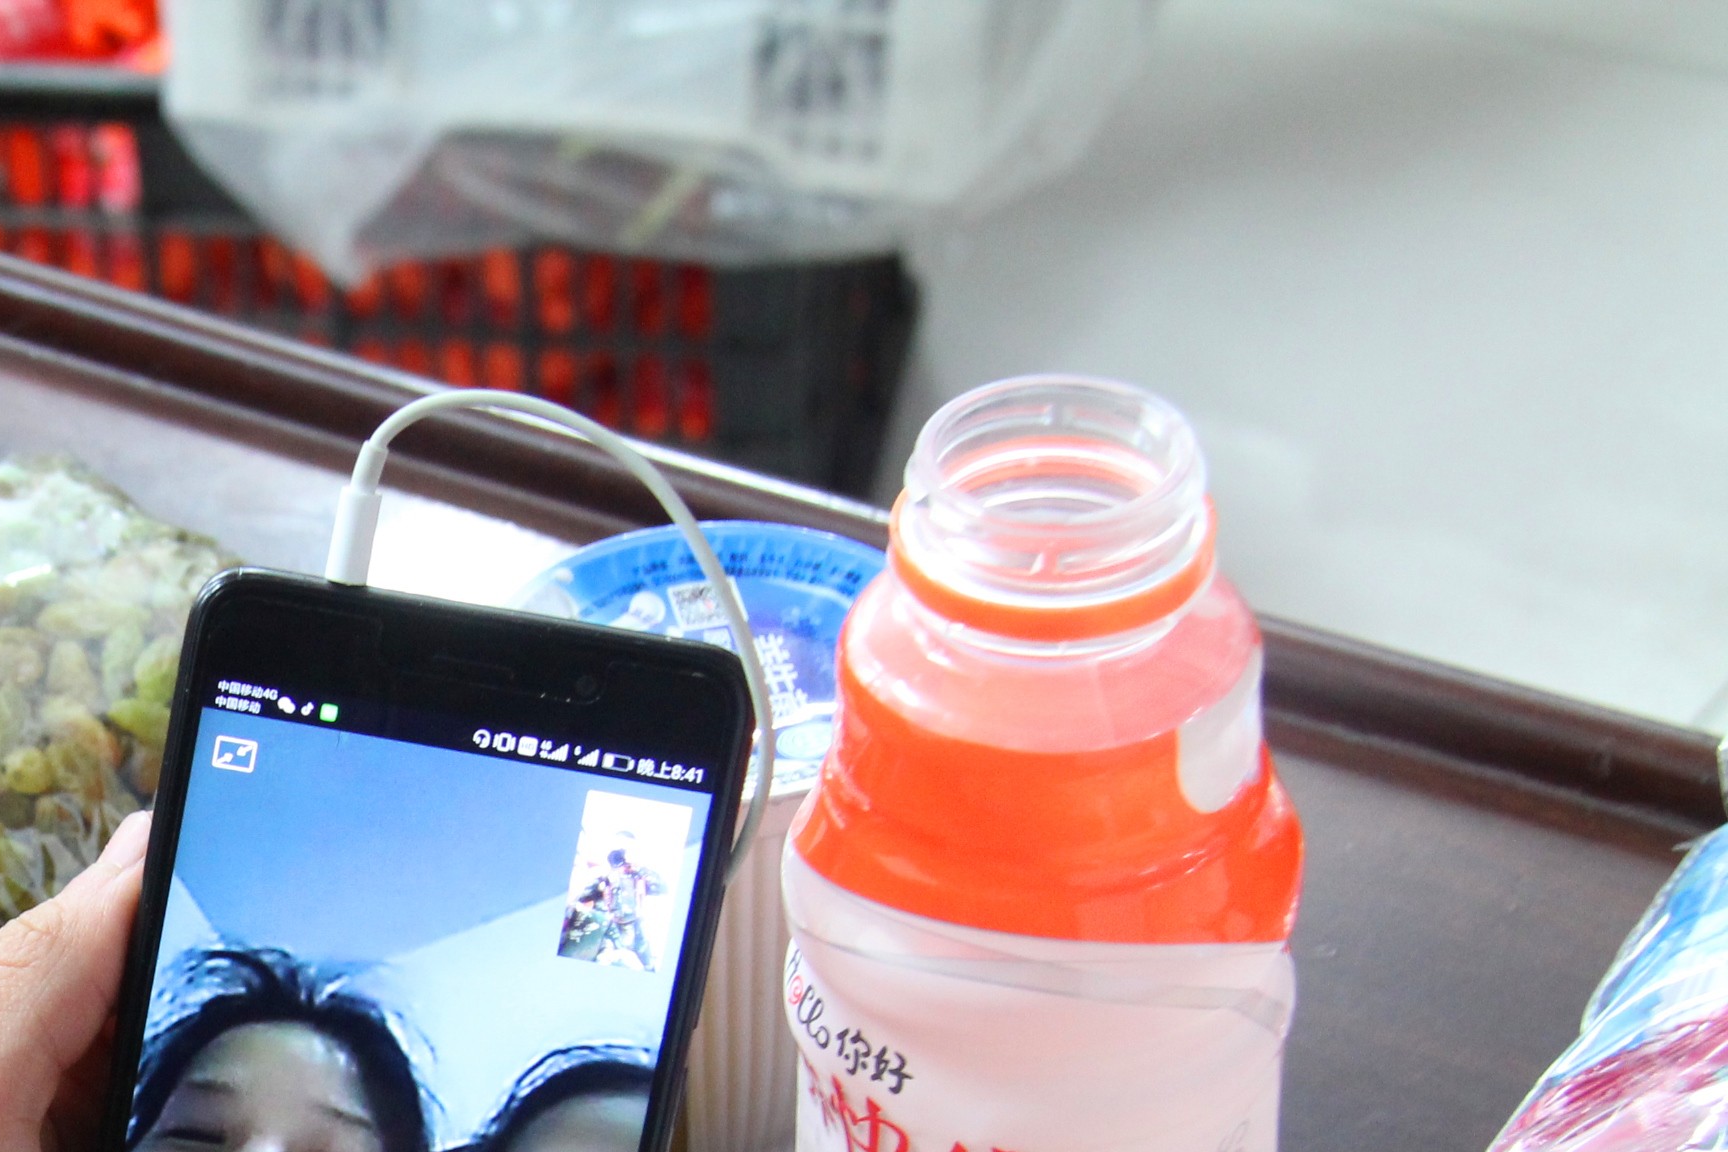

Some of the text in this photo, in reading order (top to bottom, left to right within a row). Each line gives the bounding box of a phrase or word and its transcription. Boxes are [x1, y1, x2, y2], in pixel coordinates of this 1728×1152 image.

[217, 680, 278, 701] 中国移动4G
[215, 695, 261, 714] 中国移动
[637, 758, 705, 784] 晚上8:41
[837, 1028, 914, 1094] 你好
